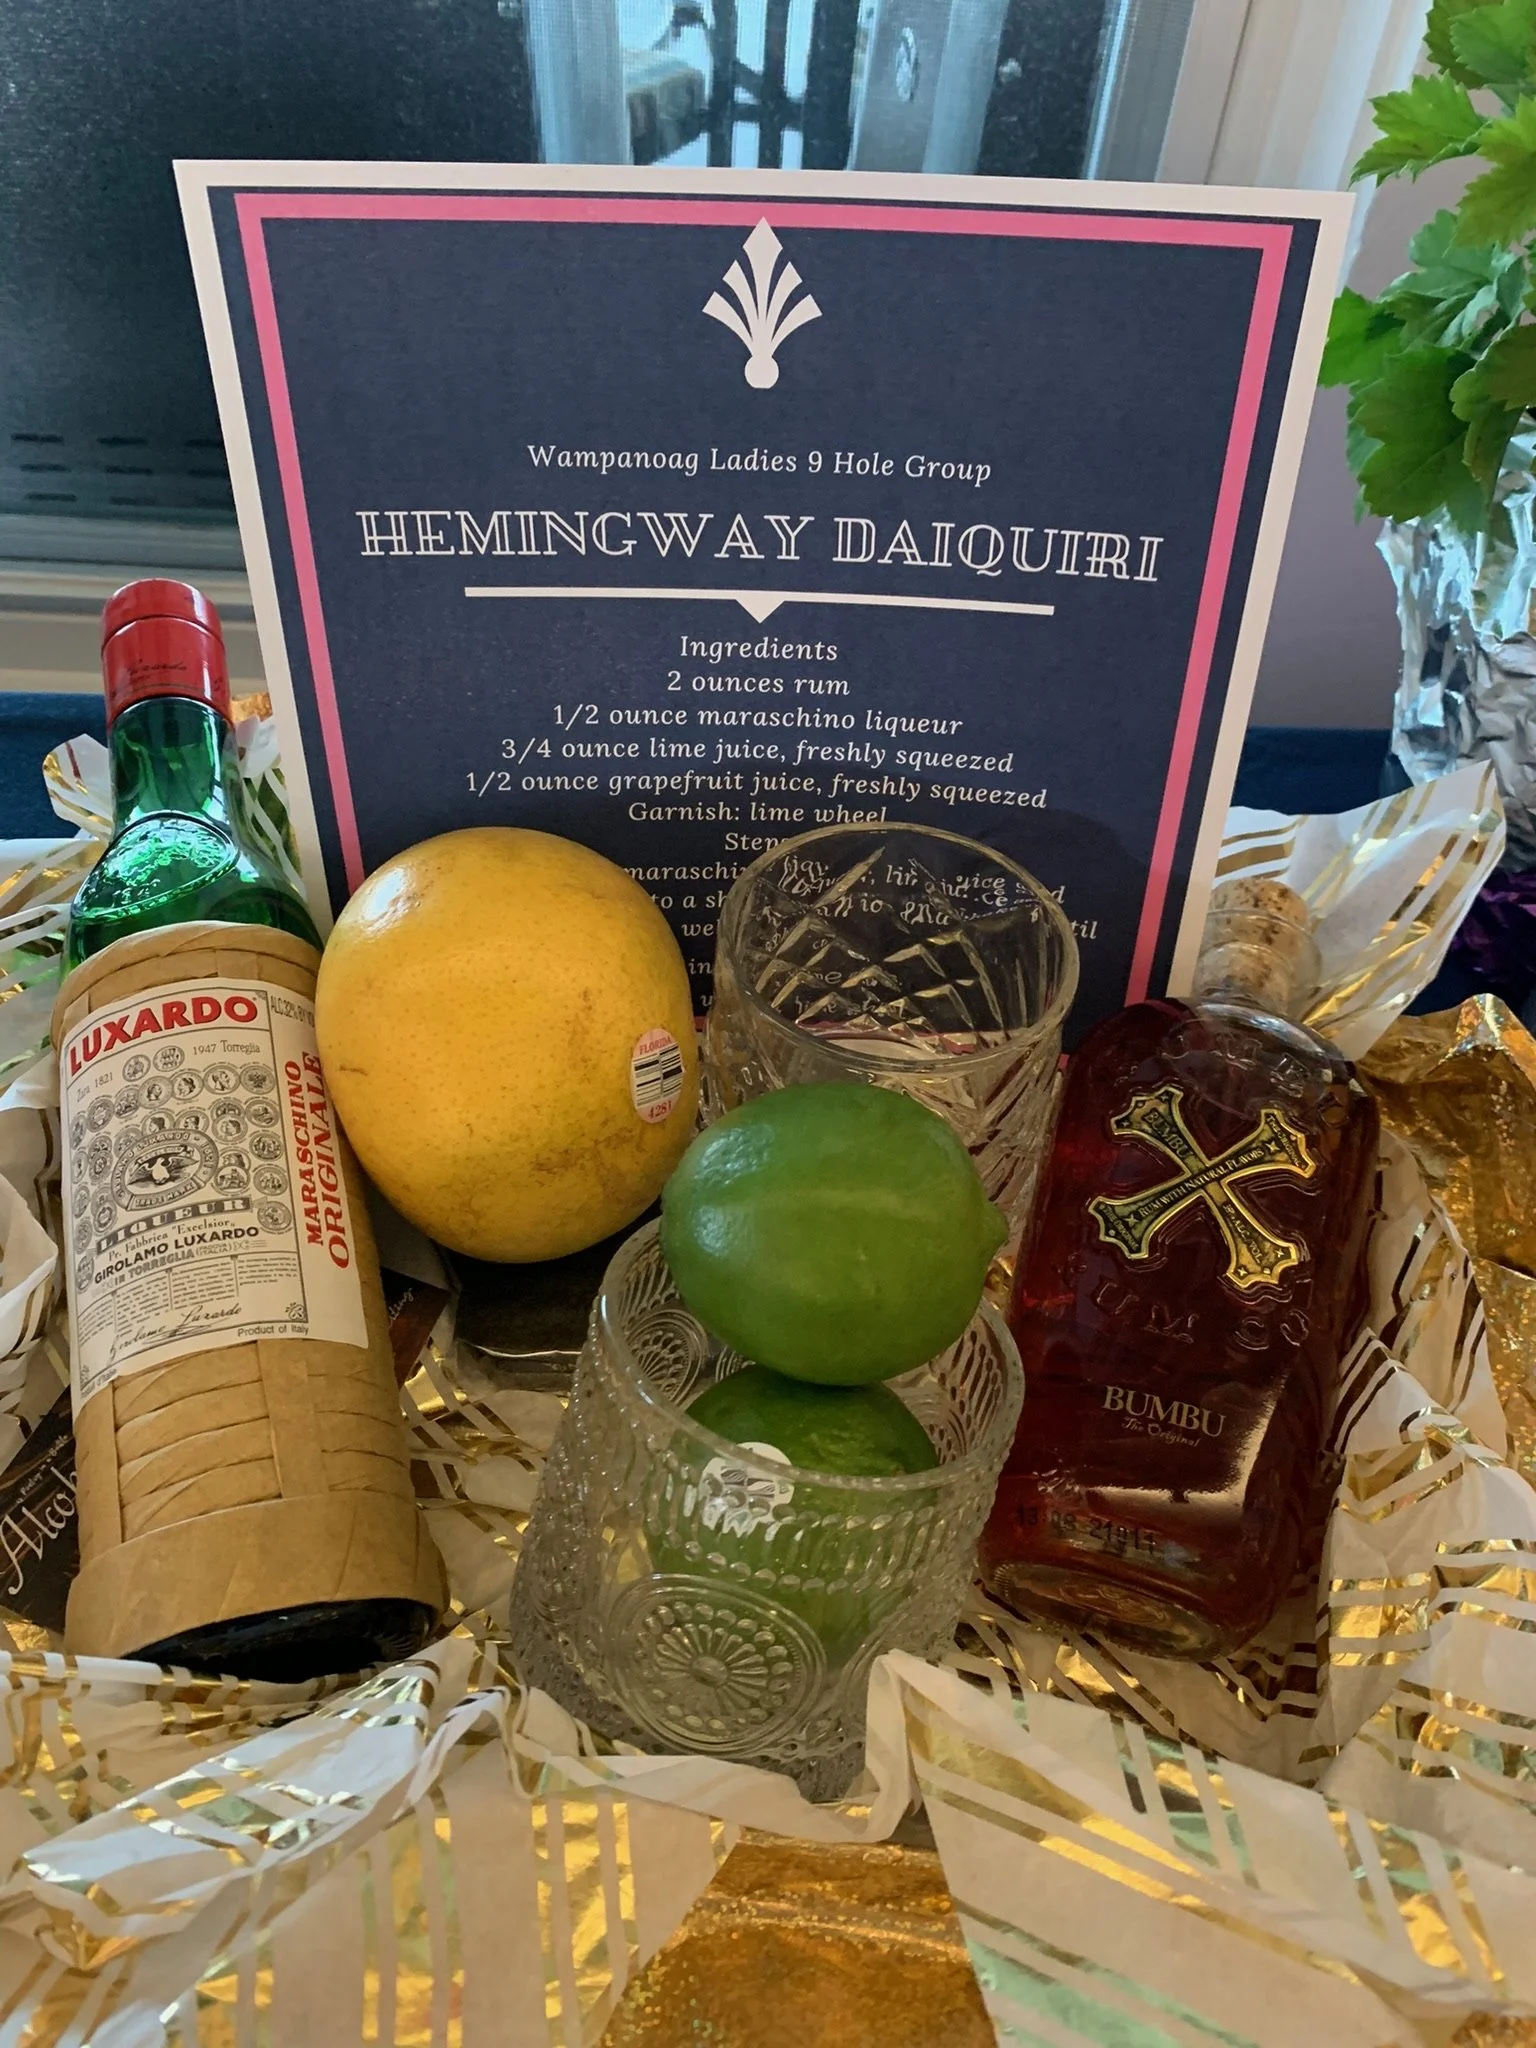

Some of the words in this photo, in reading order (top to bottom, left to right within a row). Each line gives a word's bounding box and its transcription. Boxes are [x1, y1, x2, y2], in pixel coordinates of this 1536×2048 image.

[527, 444, 699, 475] Wampanoag
[710, 447, 798, 473] Ladies
[808, 450, 823, 474] 9
[833, 451, 896, 478] Hole
[904, 454, 991, 487] Group
[356, 510, 814, 561] HEMINGWAY
[832, 516, 1164, 582] DAIQUIRI
[680, 635, 838, 666] Ingredients
[667, 670, 681, 692] 2
[691, 674, 784, 693] ounces
[794, 676, 850, 695] rum
[553, 704, 599, 731] 1/2
[609, 706, 687, 726] ounce
[697, 707, 856, 731] maraschino
[865, 710, 963, 737] liqueur
[501, 738, 551, 765] 3/4
[561, 740, 639, 760] ounce
[649, 737, 706, 759] lime
[713, 738, 787, 766] juice,
[791, 740, 886, 769] freshly
[895, 746, 1014, 774] squeezed
[465, 772, 512, 798] 1/2
[521, 773, 599, 792] ounce
[608, 770, 744, 799] grapefruit
[749, 773, 823, 799] juice,
[826, 774, 921, 804] freshly
[930, 783, 1047, 810] squeezed
[628, 802, 740, 823] Garnish:
[750, 802, 807, 822] lime
[814, 805, 887, 824] wheel
[623, 862, 749, 881] maraschi
[683, 899, 697, 909] a
[70, 996, 257, 1076] LUXARDO
[193, 1044, 216, 1056] 1947
[221, 1040, 260, 1055] Torreglia
[640, 1036, 672, 1054] FLORIDA
[95, 1072, 113, 1087] 1821
[1144, 1111, 1193, 1158] BUMBU
[285, 1060, 324, 1245] MARASCHINO
[303, 1052, 350, 1269] ORIGINALE
[1160, 1187, 1187, 1206] WITH
[1186, 1166, 1229, 1189] NATURAL
[98, 1200, 245, 1250] LIQUEUR
[95, 1243, 169, 1284] GIROLAMO
[174, 1226, 260, 1249] LUXARDO
[125, 1233, 169, 1253] Fabbrica
[130, 1249, 196, 1278] TORREGLIA
[237, 1326, 274, 1337] Product
[278, 1324, 287, 1334] of
[291, 1324, 309, 1336] Italy
[1101, 1385, 1227, 1438] BUMBU
[1121, 1416, 1144, 1432] The
[1148, 1423, 1201, 1447] Original
